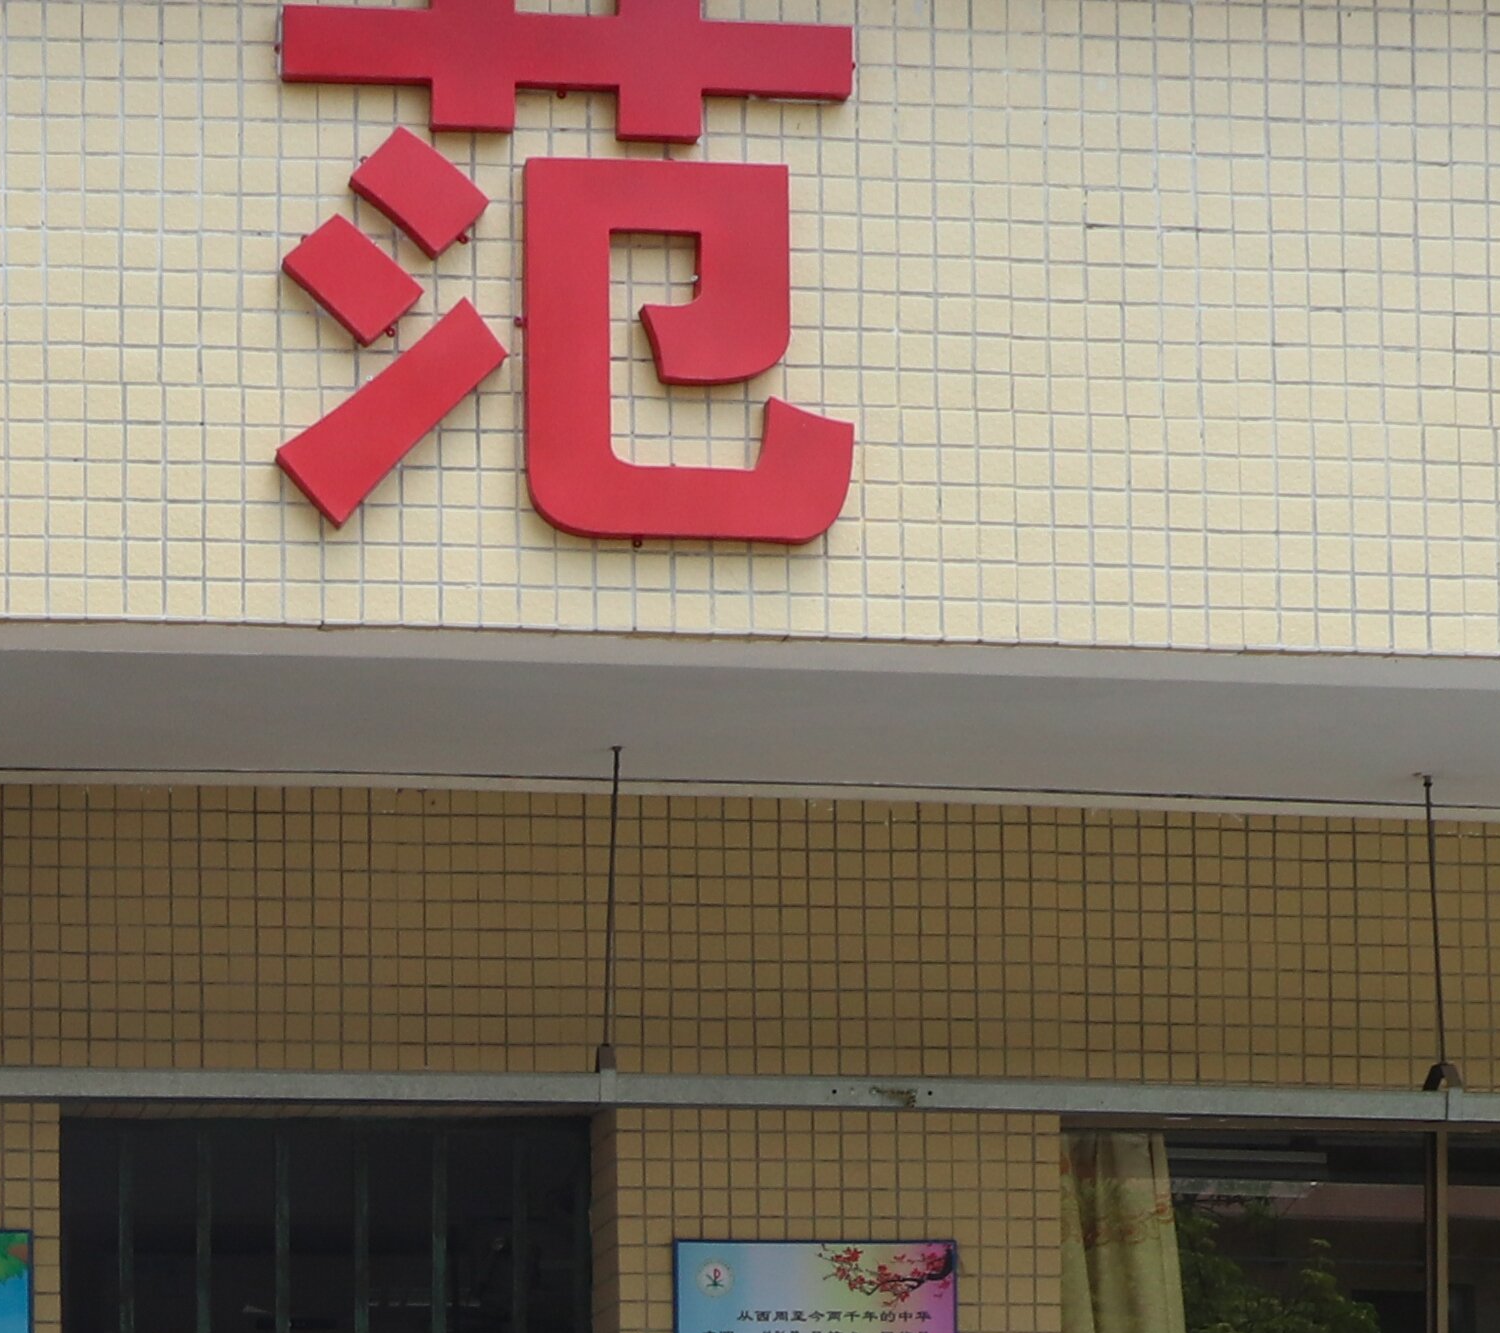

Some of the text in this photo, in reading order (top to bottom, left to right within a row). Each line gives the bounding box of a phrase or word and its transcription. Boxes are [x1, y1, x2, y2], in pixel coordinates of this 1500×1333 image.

[737, 1310, 932, 1323] 从西周至今两千年的中华
